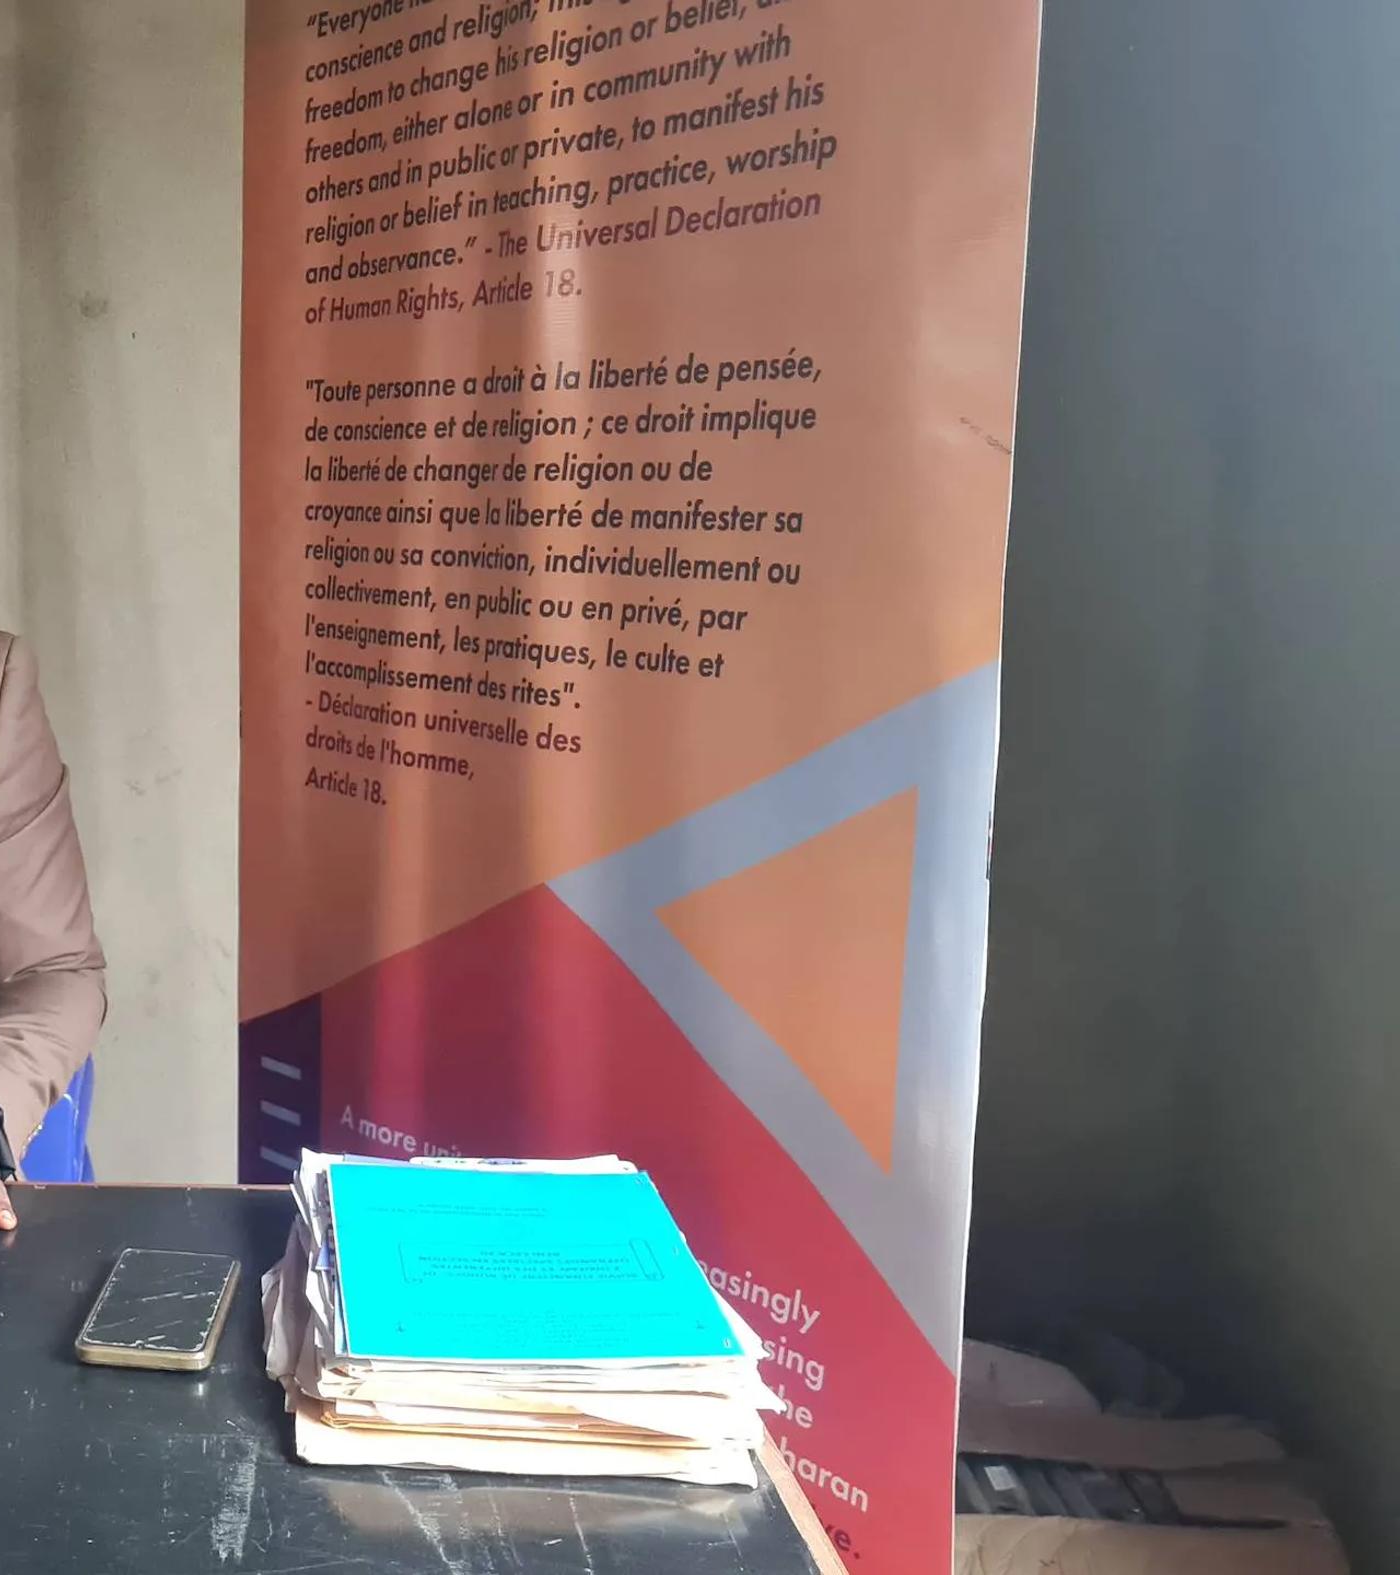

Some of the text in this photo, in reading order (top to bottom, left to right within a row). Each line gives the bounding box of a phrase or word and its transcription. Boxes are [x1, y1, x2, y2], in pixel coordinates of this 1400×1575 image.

[305, 87, 384, 124] freedom
[410, 64, 489, 92] change
[524, 26, 622, 67] religion
[306, 40, 404, 83] conscience
[409, 14, 448, 53] and
[305, 24, 791, 164] freedom, either alone community with
[306, 74, 825, 204] others and public private, manifest his
[305, 127, 837, 246] religion belief teaching, practice, worship
[306, 255, 344, 284] and
[536, 206, 659, 252] Universal
[665, 187, 822, 237] Declaration
[330, 268, 582, 323] Human Rights, Article 18.
[306, 347, 822, 407] "Toute personne droit liberté pensée,
[334, 398, 817, 444] conscience religion droit implique
[328, 451, 633, 489] liberté changer religion
[304, 497, 768, 533] croyance ainsi que liberté manifester
[304, 535, 762, 583] religion conviction, individuellement
[304, 575, 748, 637] collectivement, public privé, par
[305, 612, 690, 675] l'enseignement, pratiques, culte
[305, 649, 473, 696] l'accomplissement
[305, 724, 475, 780] droits l'homme,
[318, 690, 582, 753] Déclaration universelle des
[304, 766, 387, 805] Article 18.
[340, 1104, 354, 1130] A
[358, 1118, 417, 1152] more
[699, 1259, 821, 1334] asingly
[761, 1335, 825, 1392] sing
[778, 1436, 869, 1513] haran
